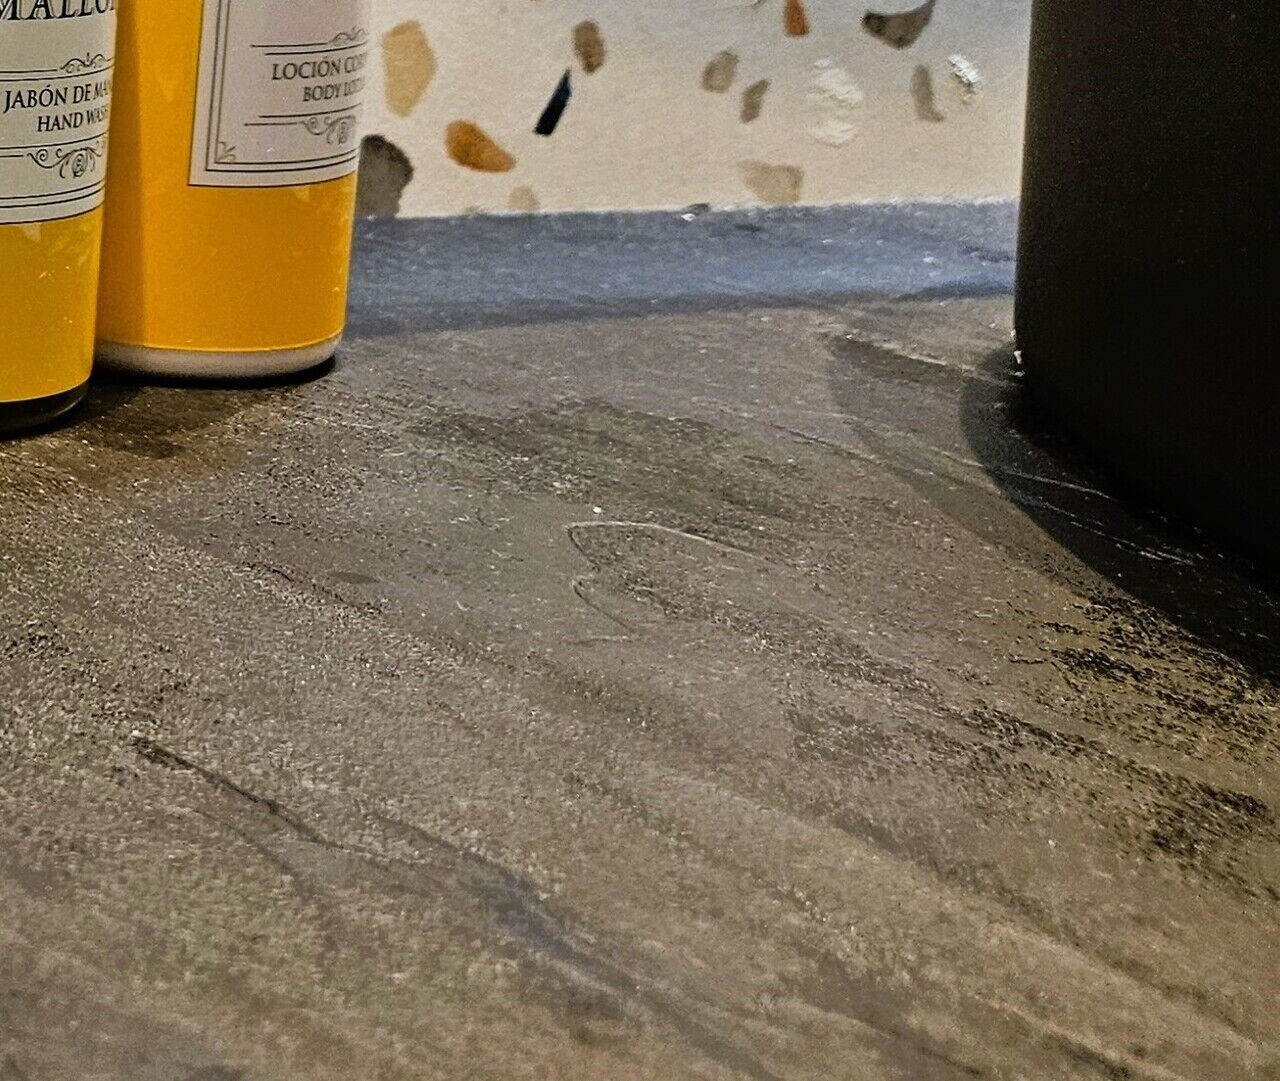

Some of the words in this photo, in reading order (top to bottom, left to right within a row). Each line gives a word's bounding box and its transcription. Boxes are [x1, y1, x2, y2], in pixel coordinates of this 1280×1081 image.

[272, 56, 342, 80] LOCIÓN
[2, 84, 69, 114] JABÓN
[73, 83, 92, 104] DE
[302, 83, 341, 102] BODY
[37, 112, 84, 133] HAND
